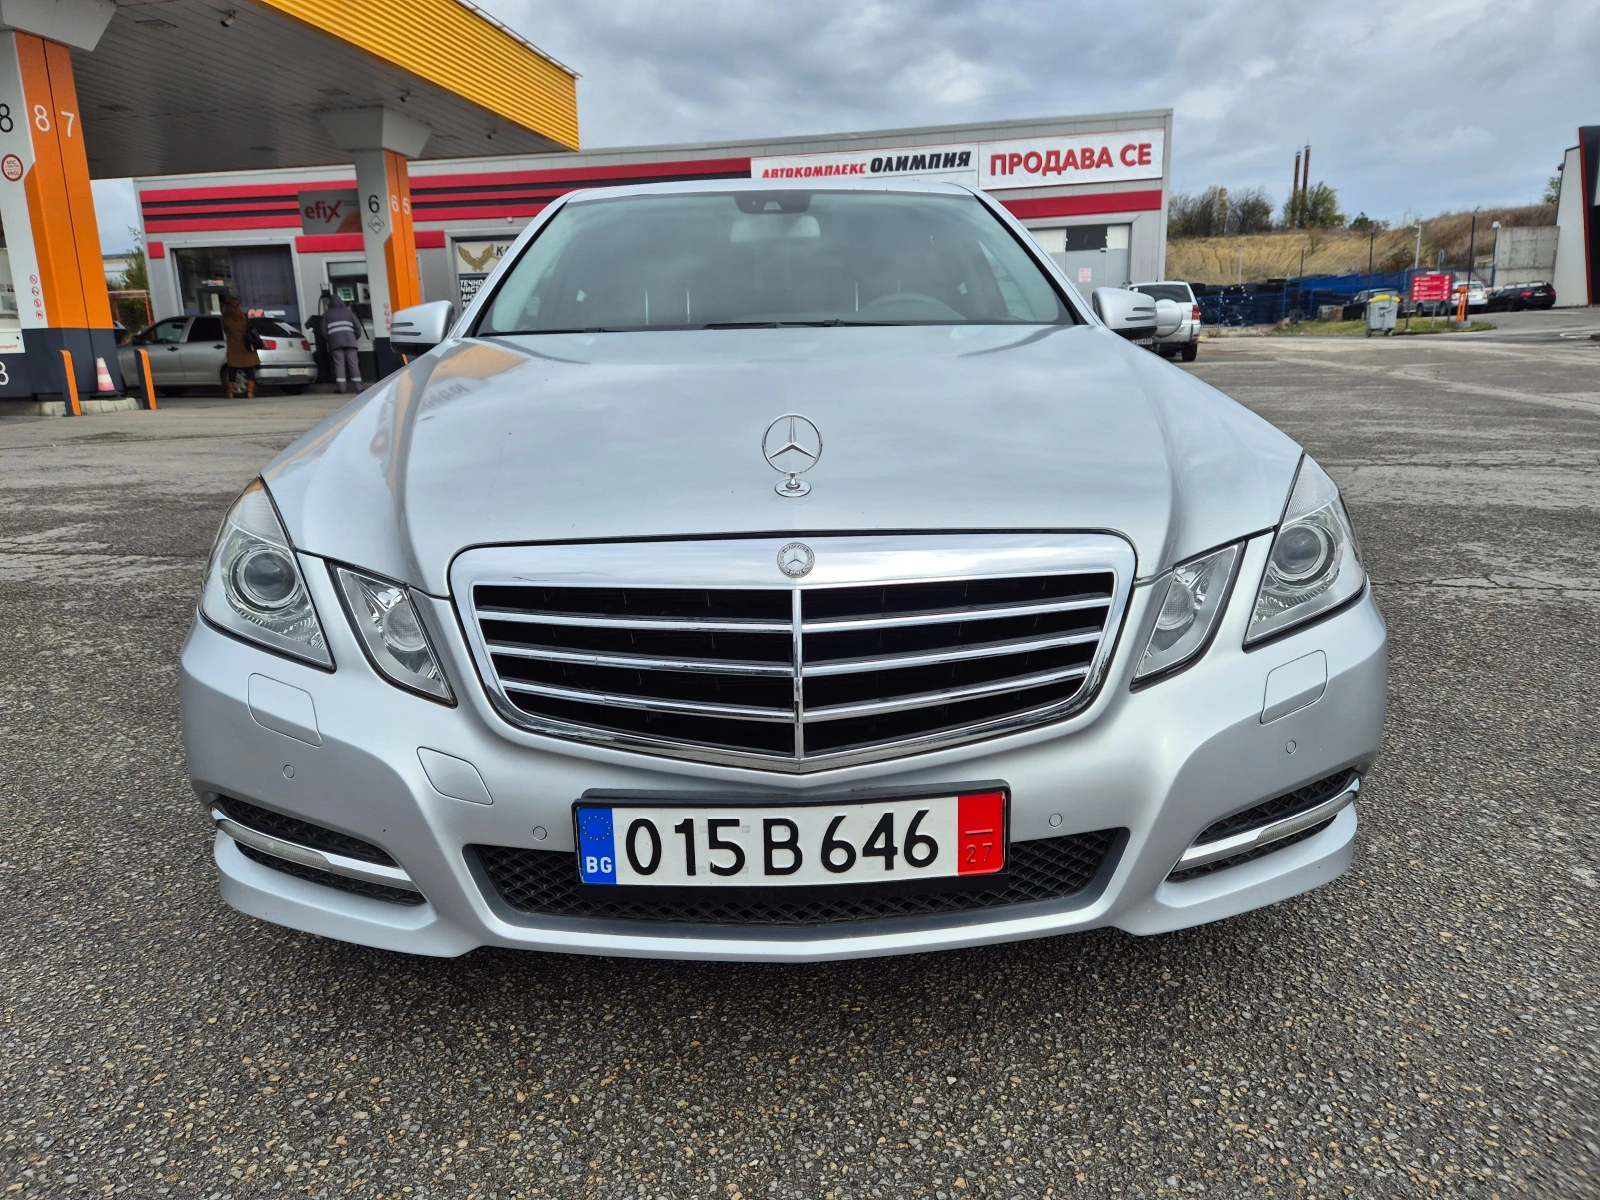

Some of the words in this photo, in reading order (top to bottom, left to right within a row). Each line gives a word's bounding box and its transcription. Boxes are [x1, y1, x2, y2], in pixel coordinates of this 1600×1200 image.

[33, 104, 51, 132] 8
[60, 110, 75, 138] 7
[762, 162, 867, 179] АВТОКОМПЛЕКС
[869, 150, 972, 174] ОЛИМПИЯ
[990, 146, 1114, 177] ПРОДАВА
[1119, 143, 1152, 167] СЕ
[304, 199, 343, 223] efix
[368, 194, 380, 214] 6
[390, 194, 400, 213] 6
[402, 197, 411, 215] 5
[586, 855, 613, 873] BG
[625, 817, 746, 877] 015
[763, 817, 803, 876] B
[820, 809, 939, 874] 646
[965, 843, 992, 865] 27
